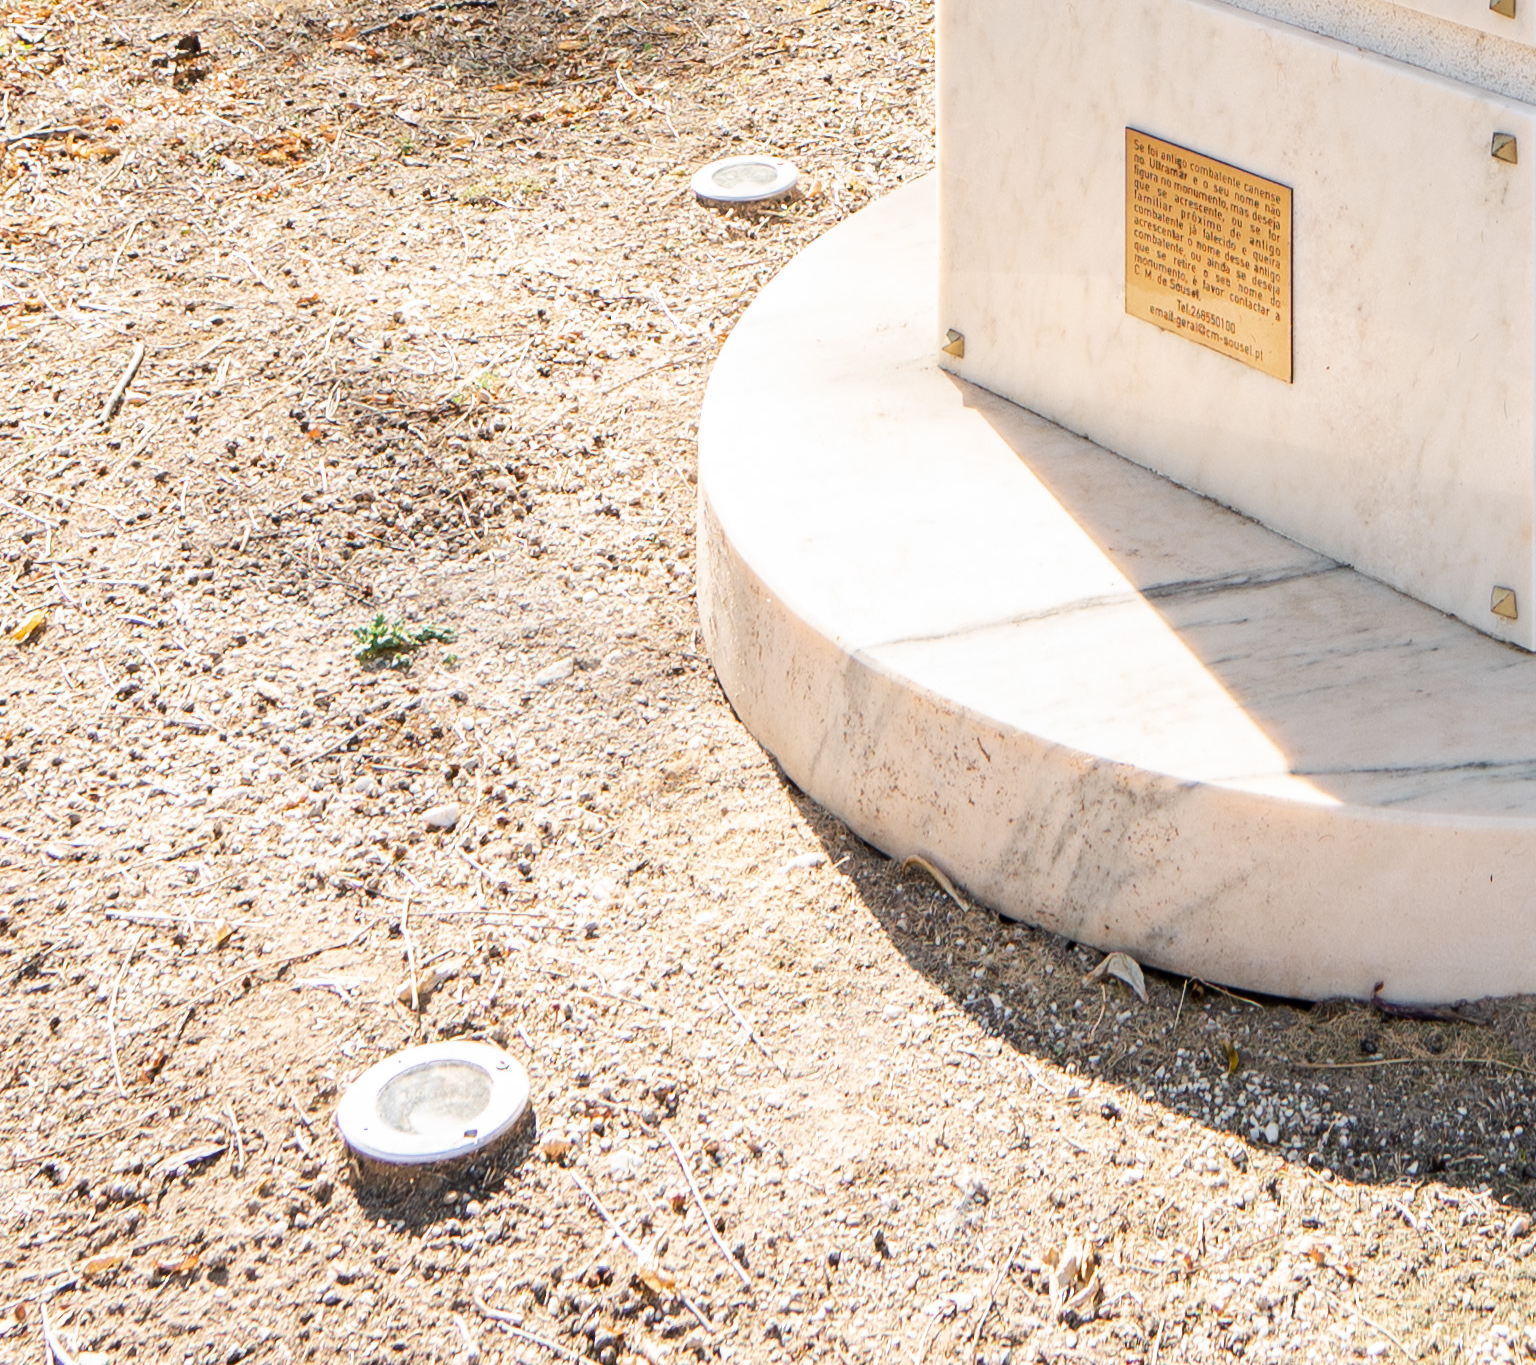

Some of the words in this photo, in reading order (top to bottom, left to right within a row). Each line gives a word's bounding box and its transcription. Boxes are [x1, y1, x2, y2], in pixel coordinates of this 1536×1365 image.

[1148, 144, 1157, 157] foi
[1161, 149, 1186, 170] antigo
[1191, 160, 1240, 188] combatente
[1244, 182, 1280, 204] canense
[1150, 158, 1187, 181] Ultramar
[1214, 184, 1228, 196] seu
[1235, 191, 1259, 208] nome
[1265, 202, 1280, 216] não
